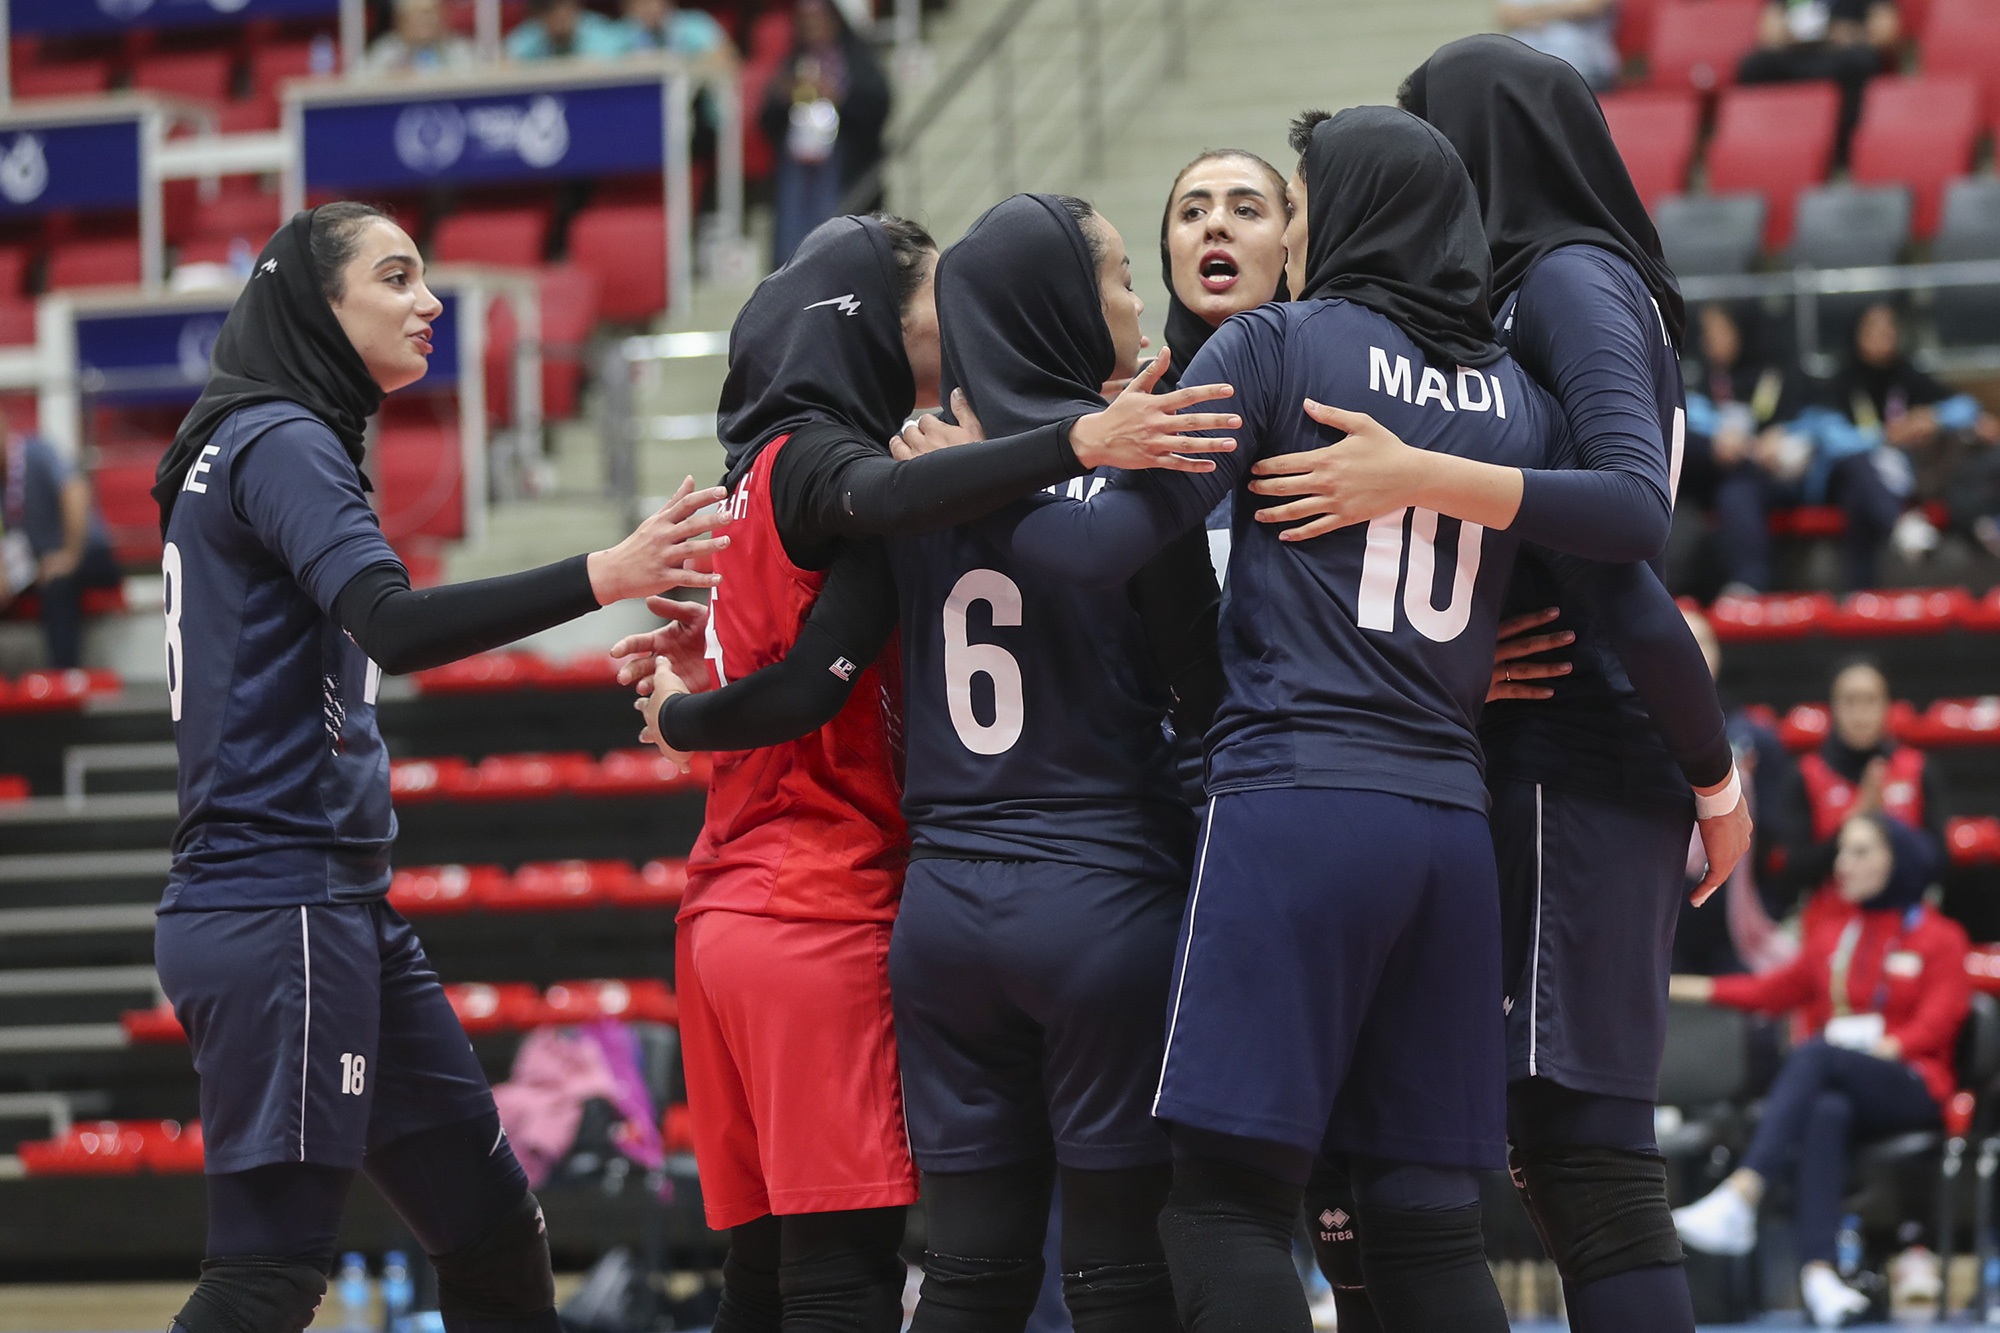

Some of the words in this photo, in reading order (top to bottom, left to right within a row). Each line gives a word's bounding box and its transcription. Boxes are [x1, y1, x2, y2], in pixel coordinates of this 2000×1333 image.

[1369, 345, 1506, 420] MADI
[943, 568, 1024, 755] 6
[340, 1052, 366, 1096] 18
